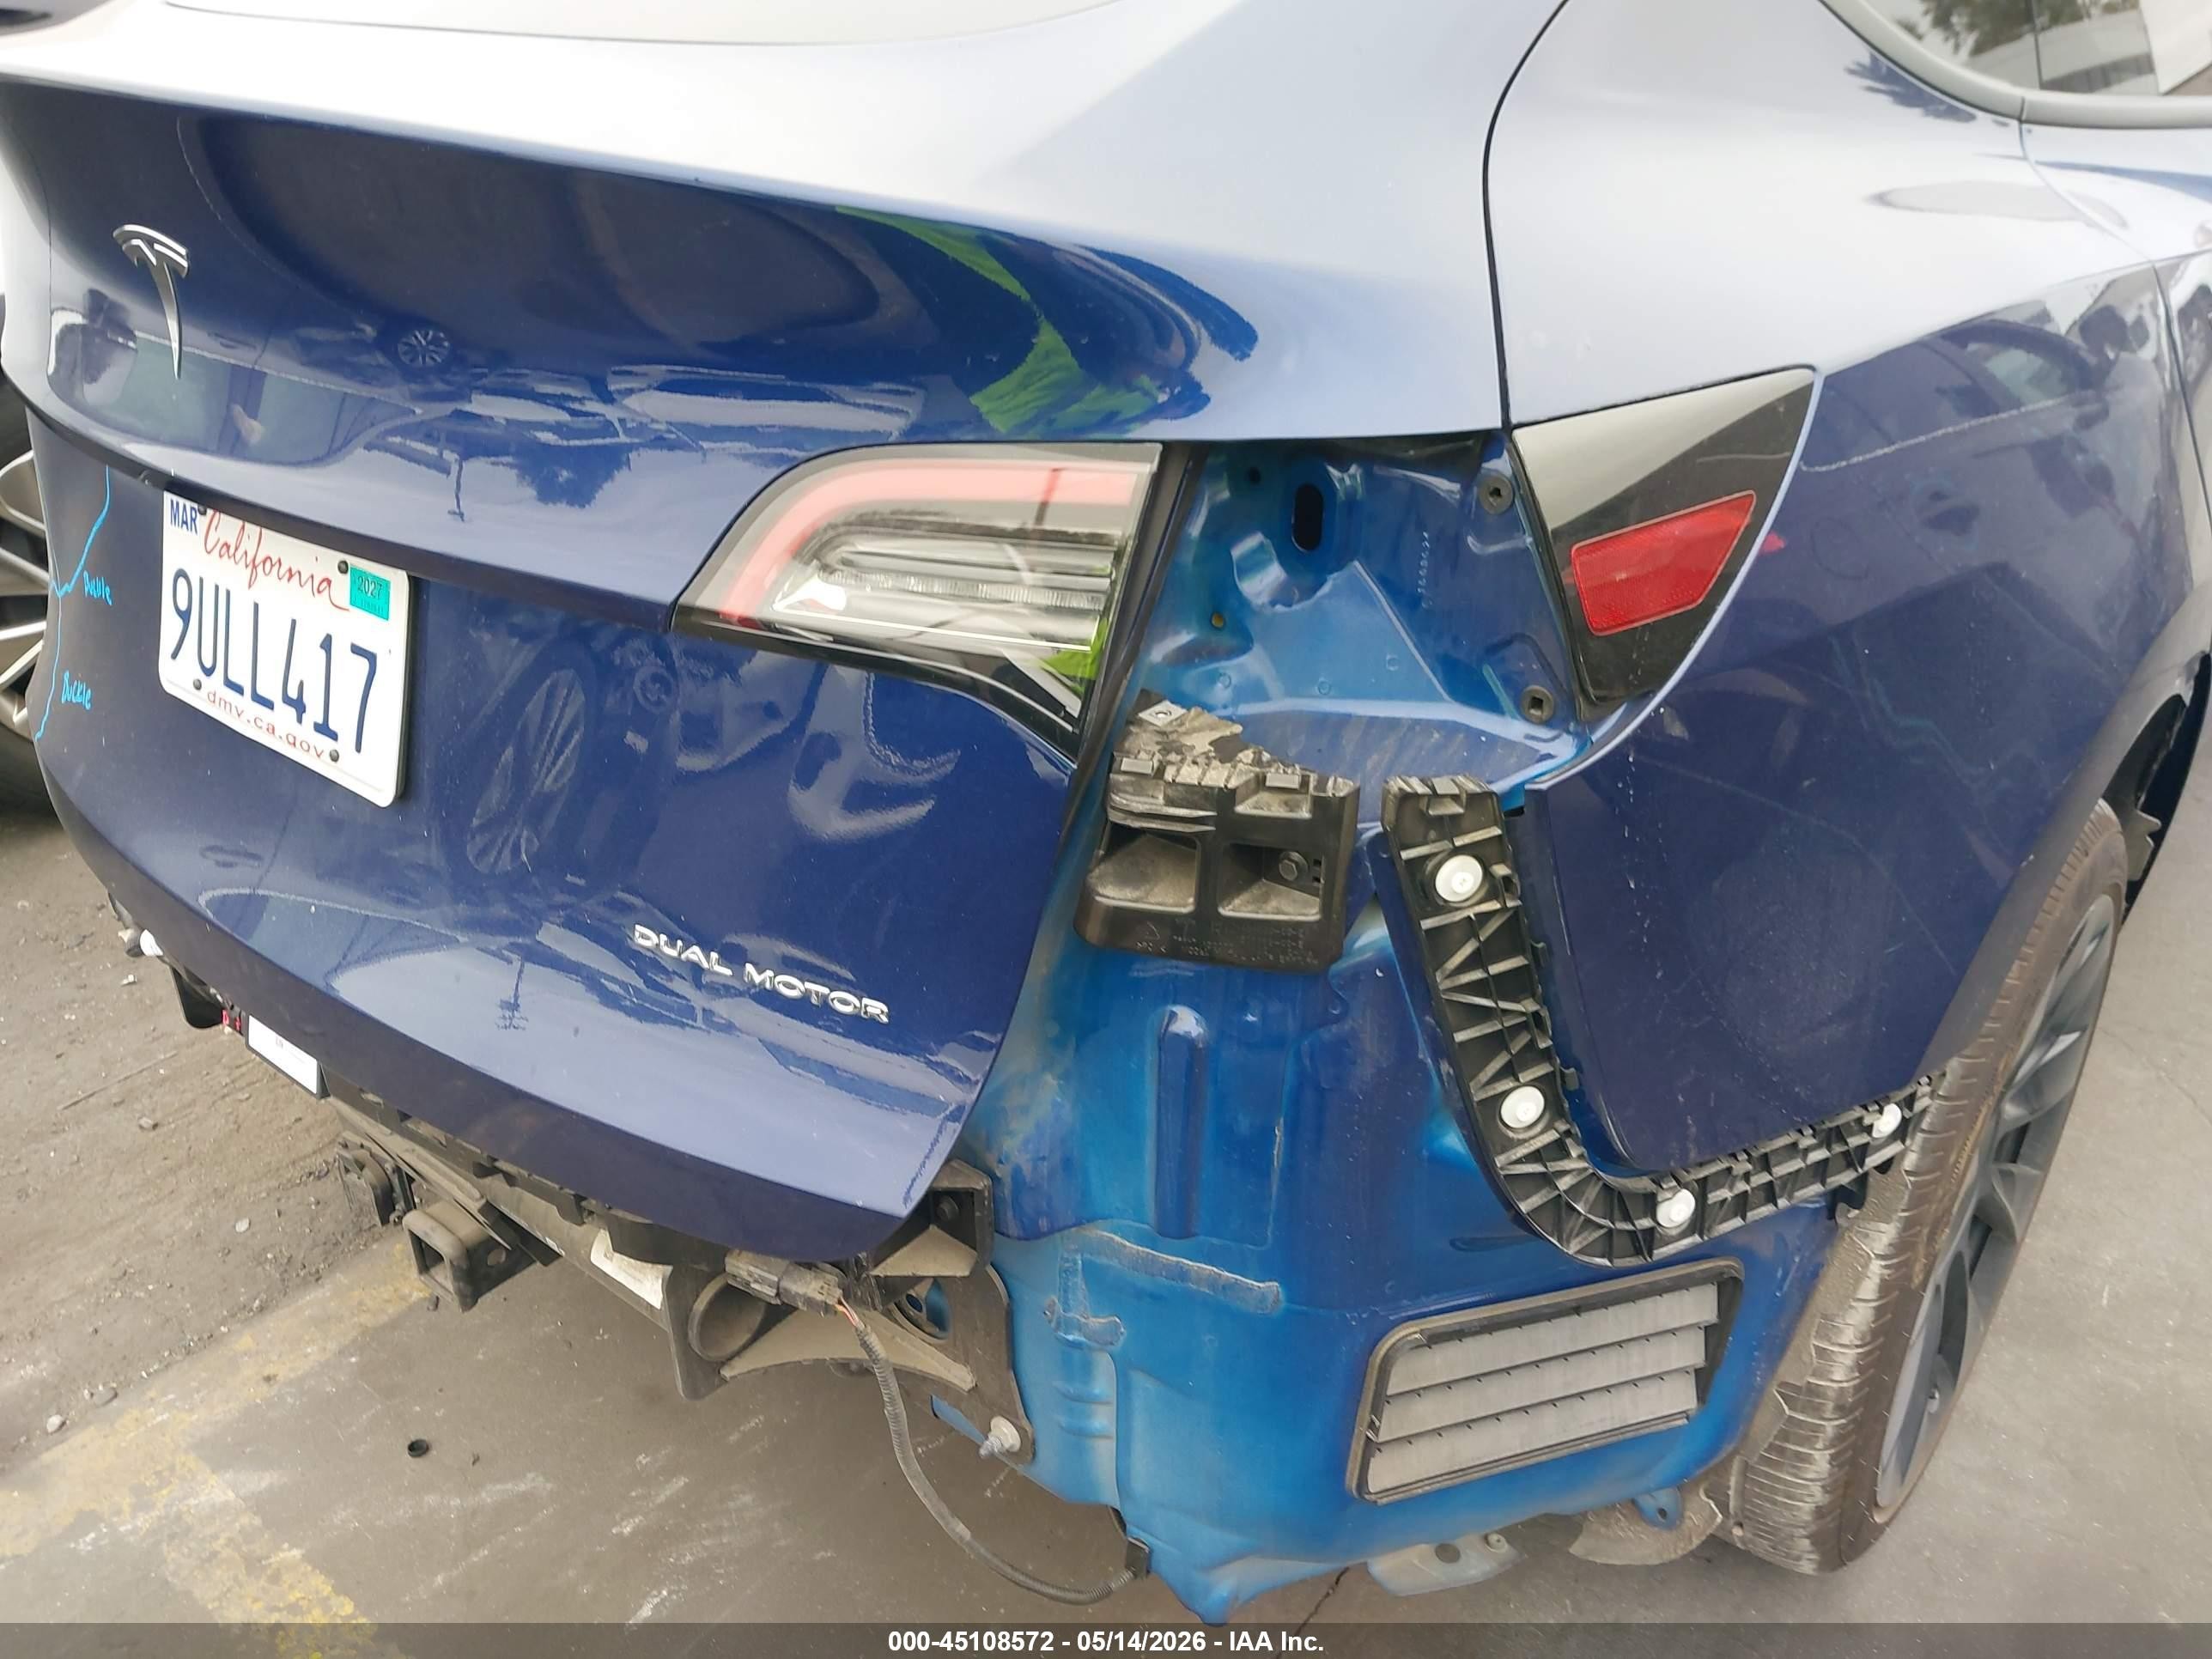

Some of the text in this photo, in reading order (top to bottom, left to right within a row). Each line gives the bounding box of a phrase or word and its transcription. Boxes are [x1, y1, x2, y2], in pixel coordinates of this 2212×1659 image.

[170, 499, 198, 536] MAR
[204, 509, 349, 611] California
[357, 575, 383, 600] 2027
[171, 568, 378, 753] 9ULL417
[207, 690, 325, 759] dmv.ca.gov
[634, 923, 890, 1024] DUAL MOTOR
